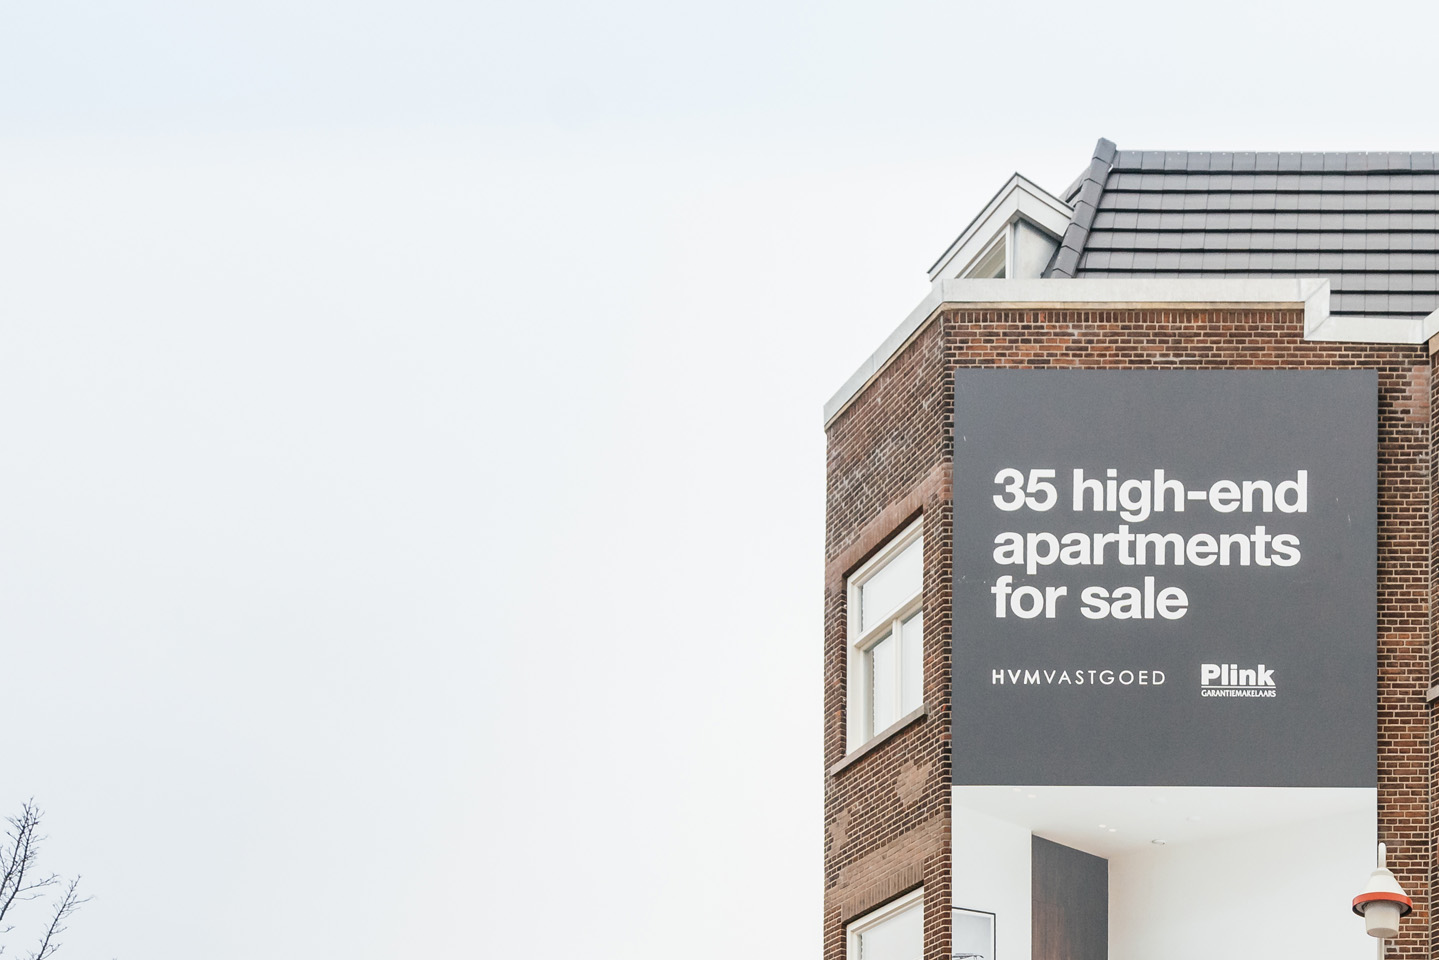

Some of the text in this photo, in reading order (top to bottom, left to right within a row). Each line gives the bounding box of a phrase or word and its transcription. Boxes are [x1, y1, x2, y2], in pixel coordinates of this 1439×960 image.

[993, 468, 1307, 522] 35 high-end
[993, 525, 1301, 574] apartments
[991, 575, 1188, 619] for sale
[1201, 664, 1275, 685] Plink
